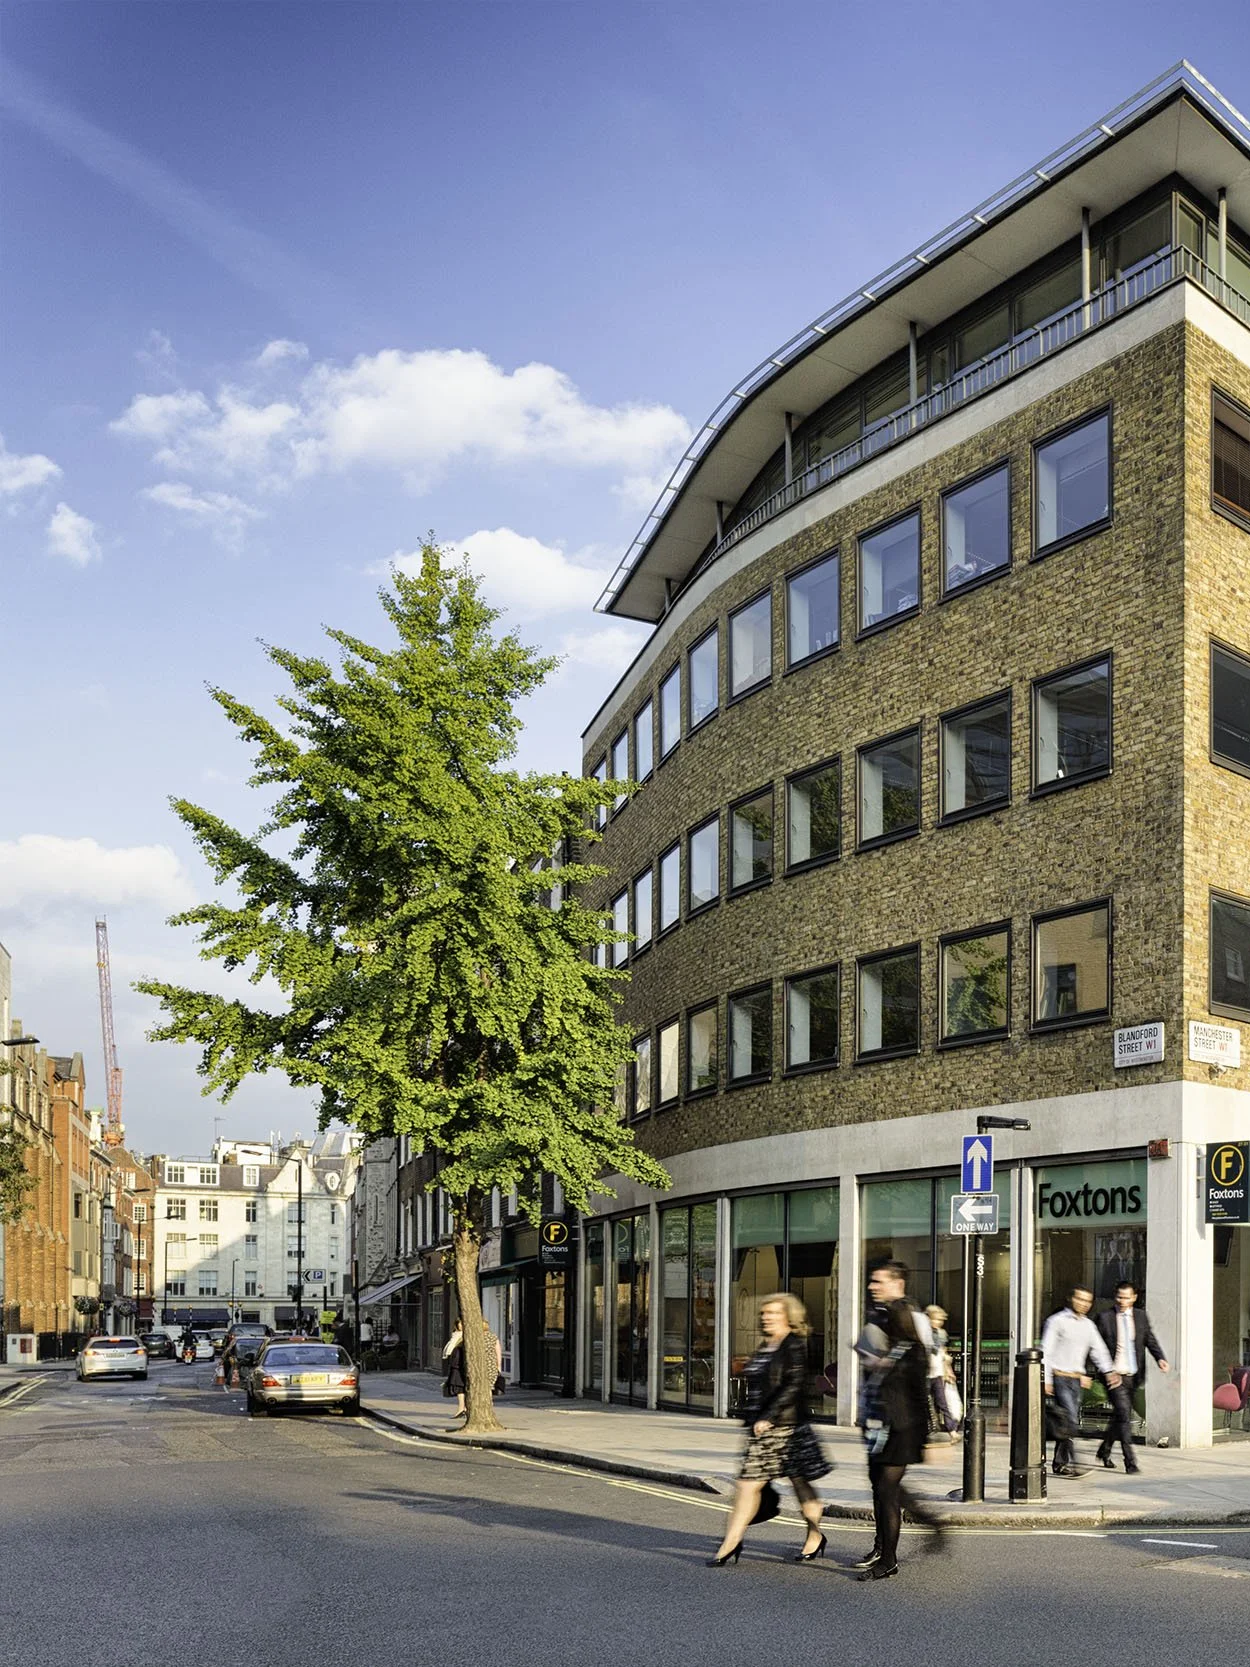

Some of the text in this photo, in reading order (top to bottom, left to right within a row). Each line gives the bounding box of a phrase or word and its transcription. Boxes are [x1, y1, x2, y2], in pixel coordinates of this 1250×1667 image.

[1118, 1027, 1158, 1043] BLANDFORD
[1193, 1025, 1233, 1042] MANCHESTER
[1118, 1040, 1157, 1055] STREET W1
[1193, 1036, 1216, 1050] STREET
[1220, 1151, 1234, 1180] F
[1038, 1182, 1143, 1218] Foxtons
[1209, 1188, 1244, 1199] Foxtons
[549, 1224, 561, 1241] F
[955, 1223, 994, 1232] ONE WAY
[315, 1271, 322, 1279] P
